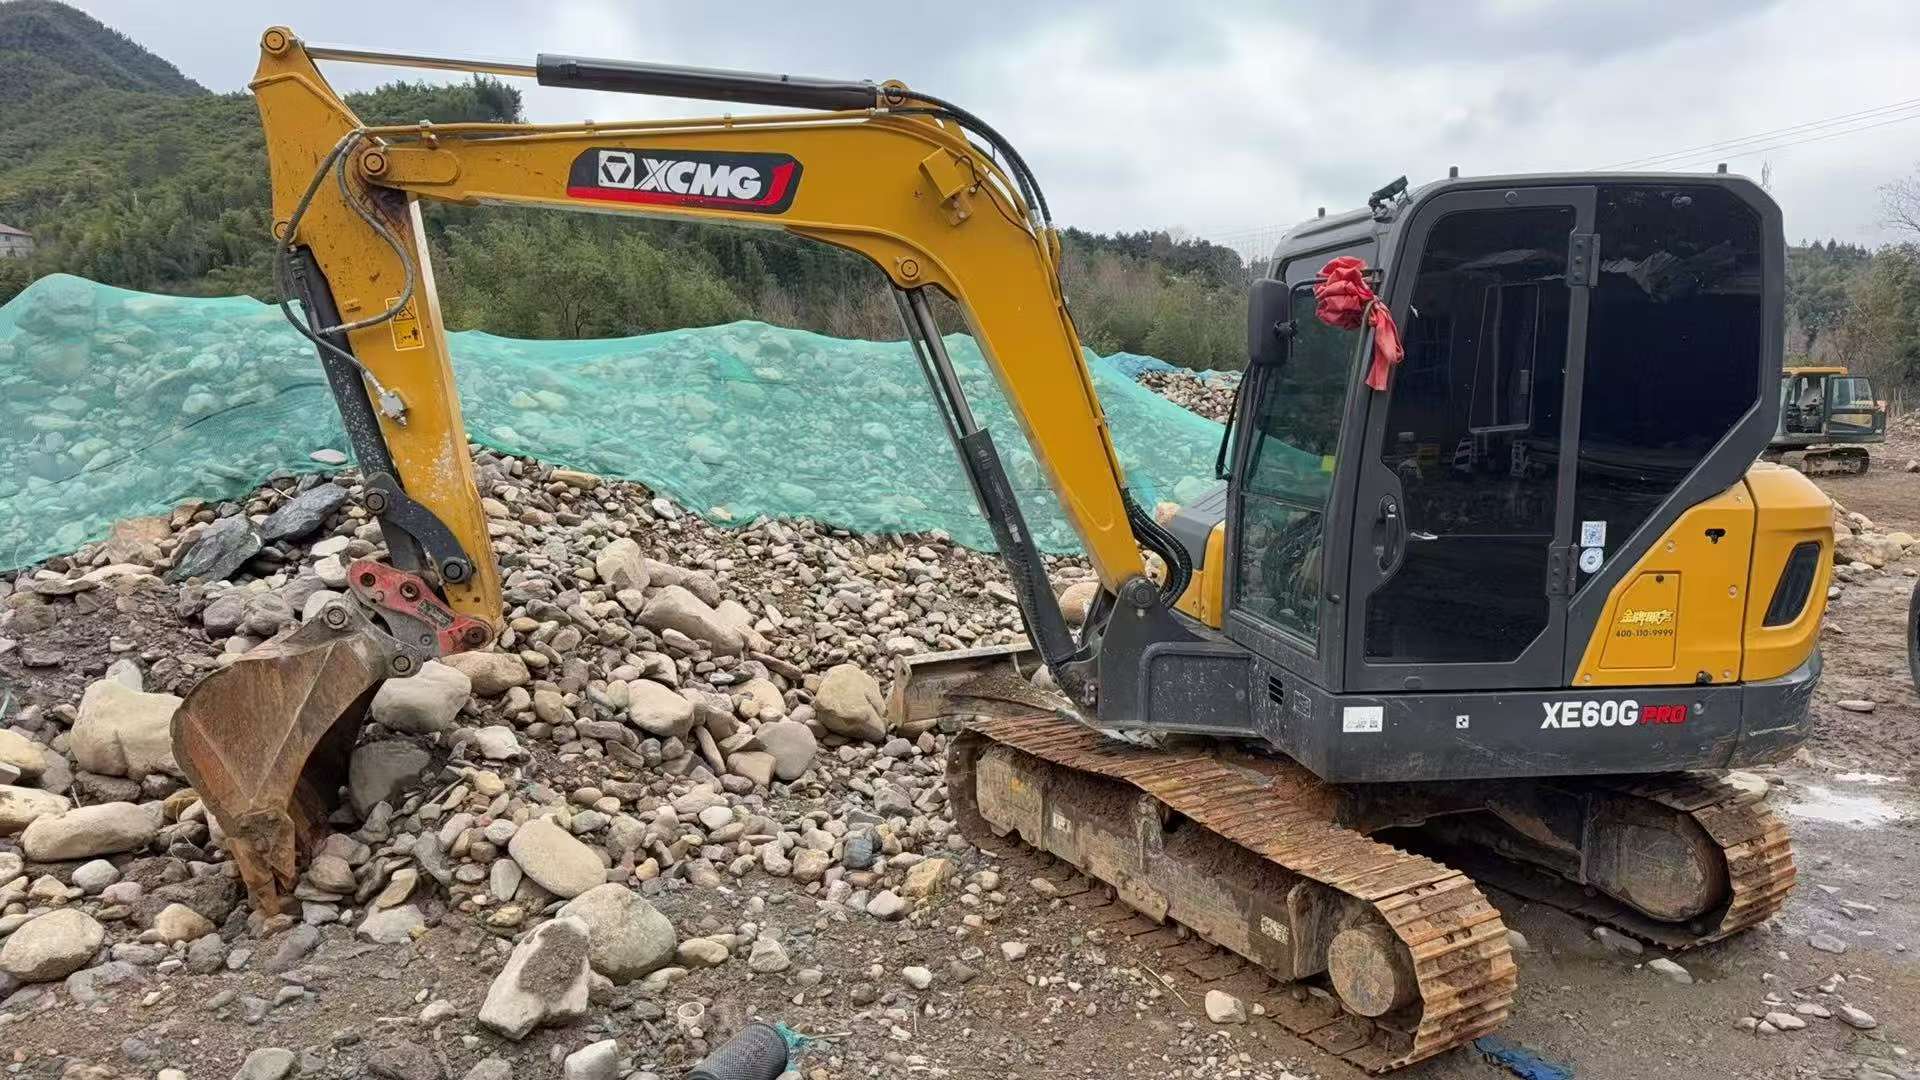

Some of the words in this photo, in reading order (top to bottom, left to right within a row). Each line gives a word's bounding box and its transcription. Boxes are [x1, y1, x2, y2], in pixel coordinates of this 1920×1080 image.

[636, 158, 761, 200] XCMG
[1616, 629, 1674, 638] 400-110-9999
[1541, 700, 1639, 729] XE60G
[1641, 704, 1688, 724] PRO
